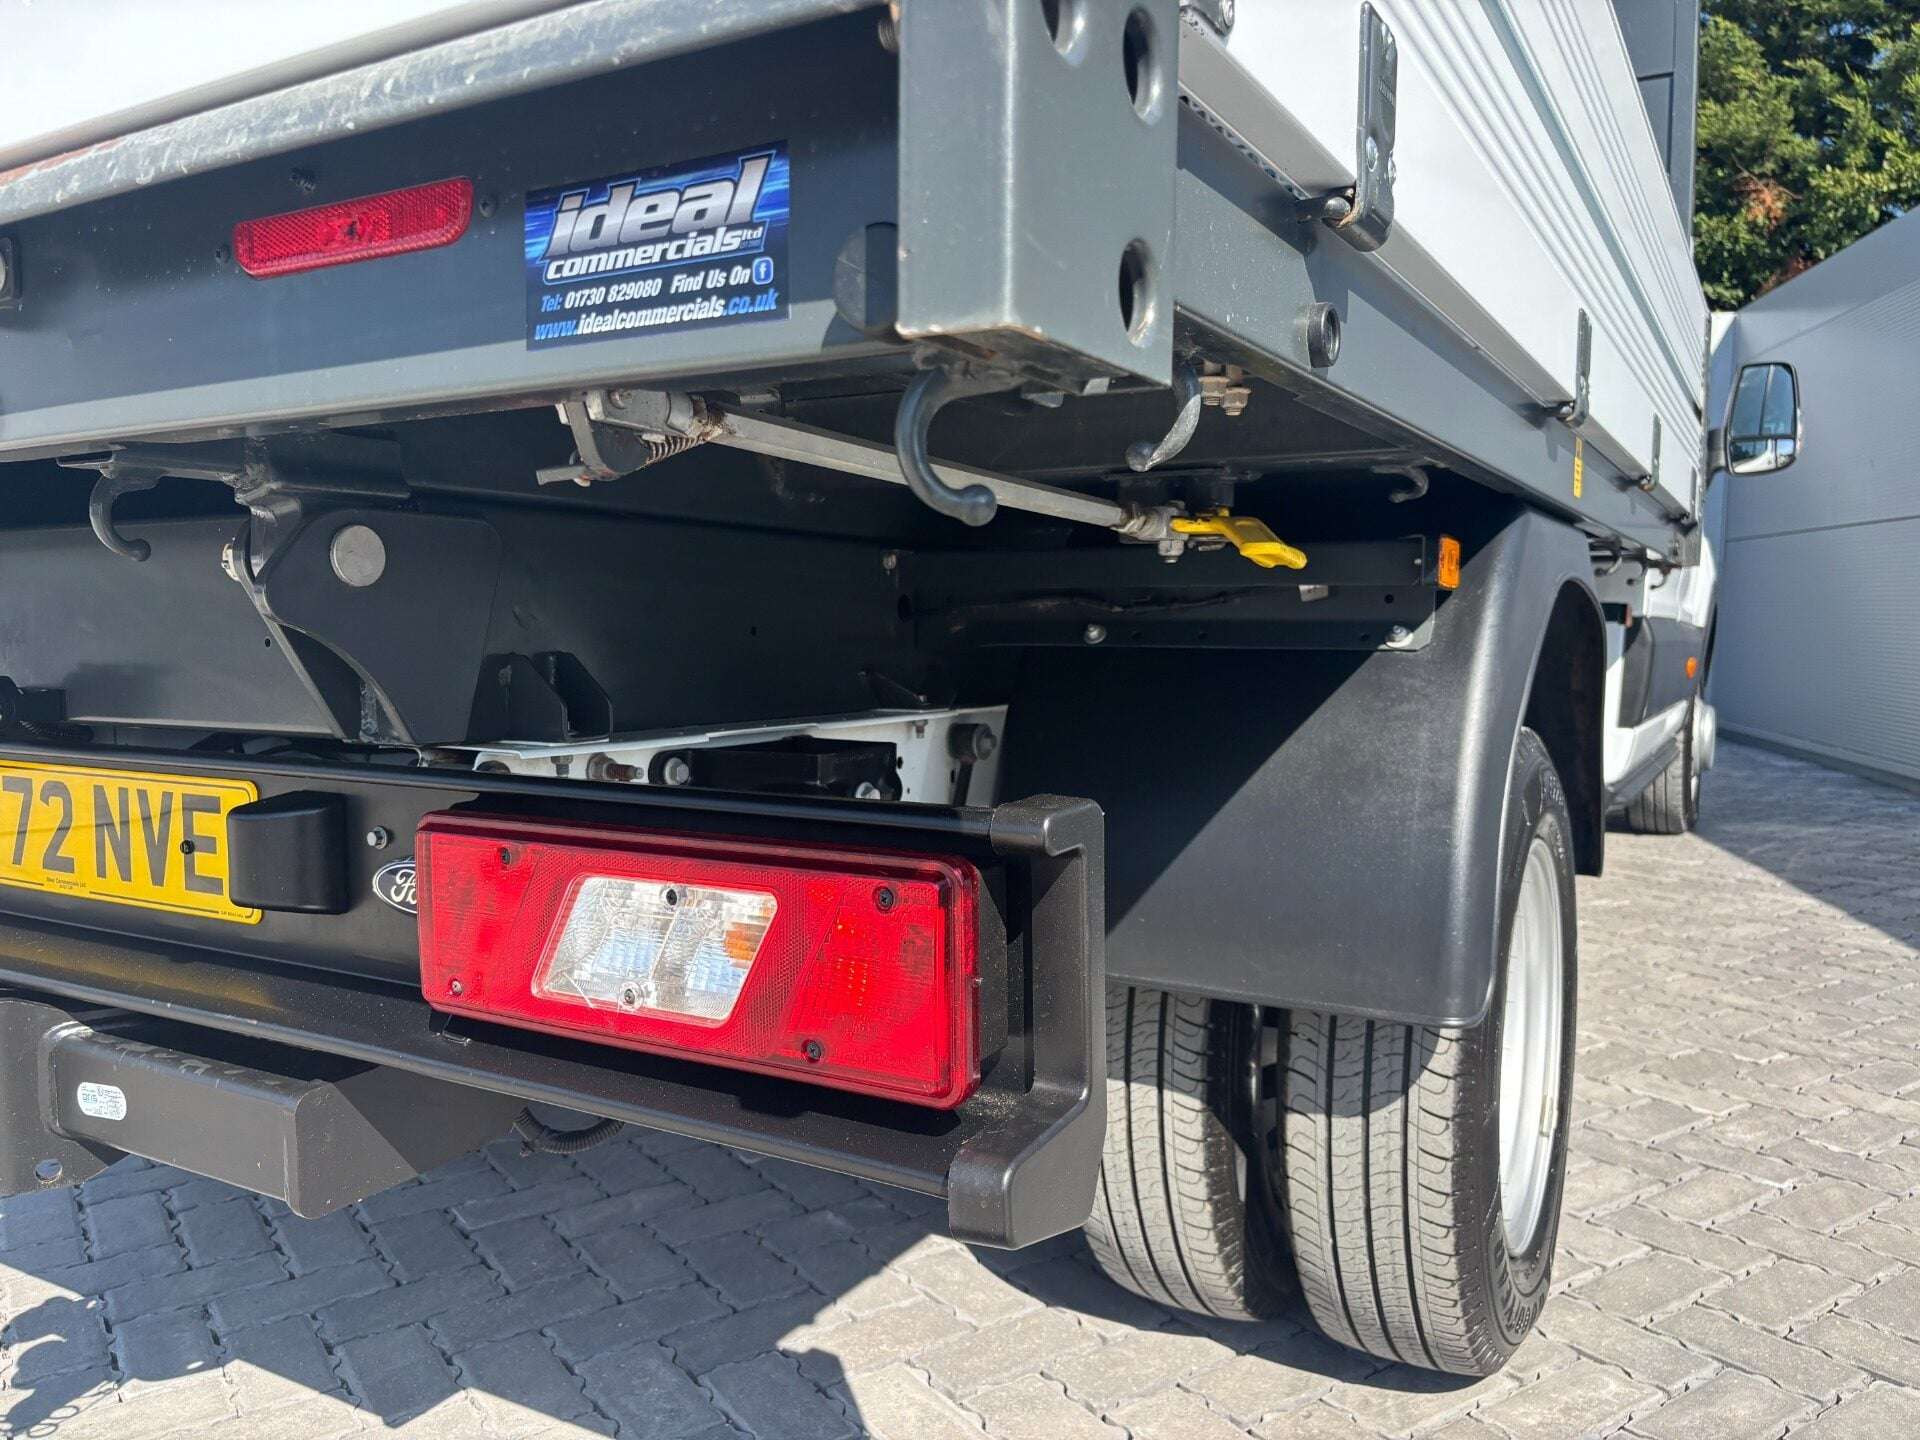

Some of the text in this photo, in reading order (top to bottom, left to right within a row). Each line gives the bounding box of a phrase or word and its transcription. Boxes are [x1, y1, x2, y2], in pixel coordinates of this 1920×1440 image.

[543, 154, 771, 257] ideal
[546, 226, 743, 280] commercials
[534, 288, 779, 341] www.idealcommercials.co.uk
[540, 295, 562, 313] Tel:
[564, 289, 605, 310] 01730
[607, 278, 661, 303] 829080
[670, 270, 703, 295] Find
[706, 268, 727, 289] Us
[729, 265, 751, 286] On
[93, 784, 225, 897] NVE
